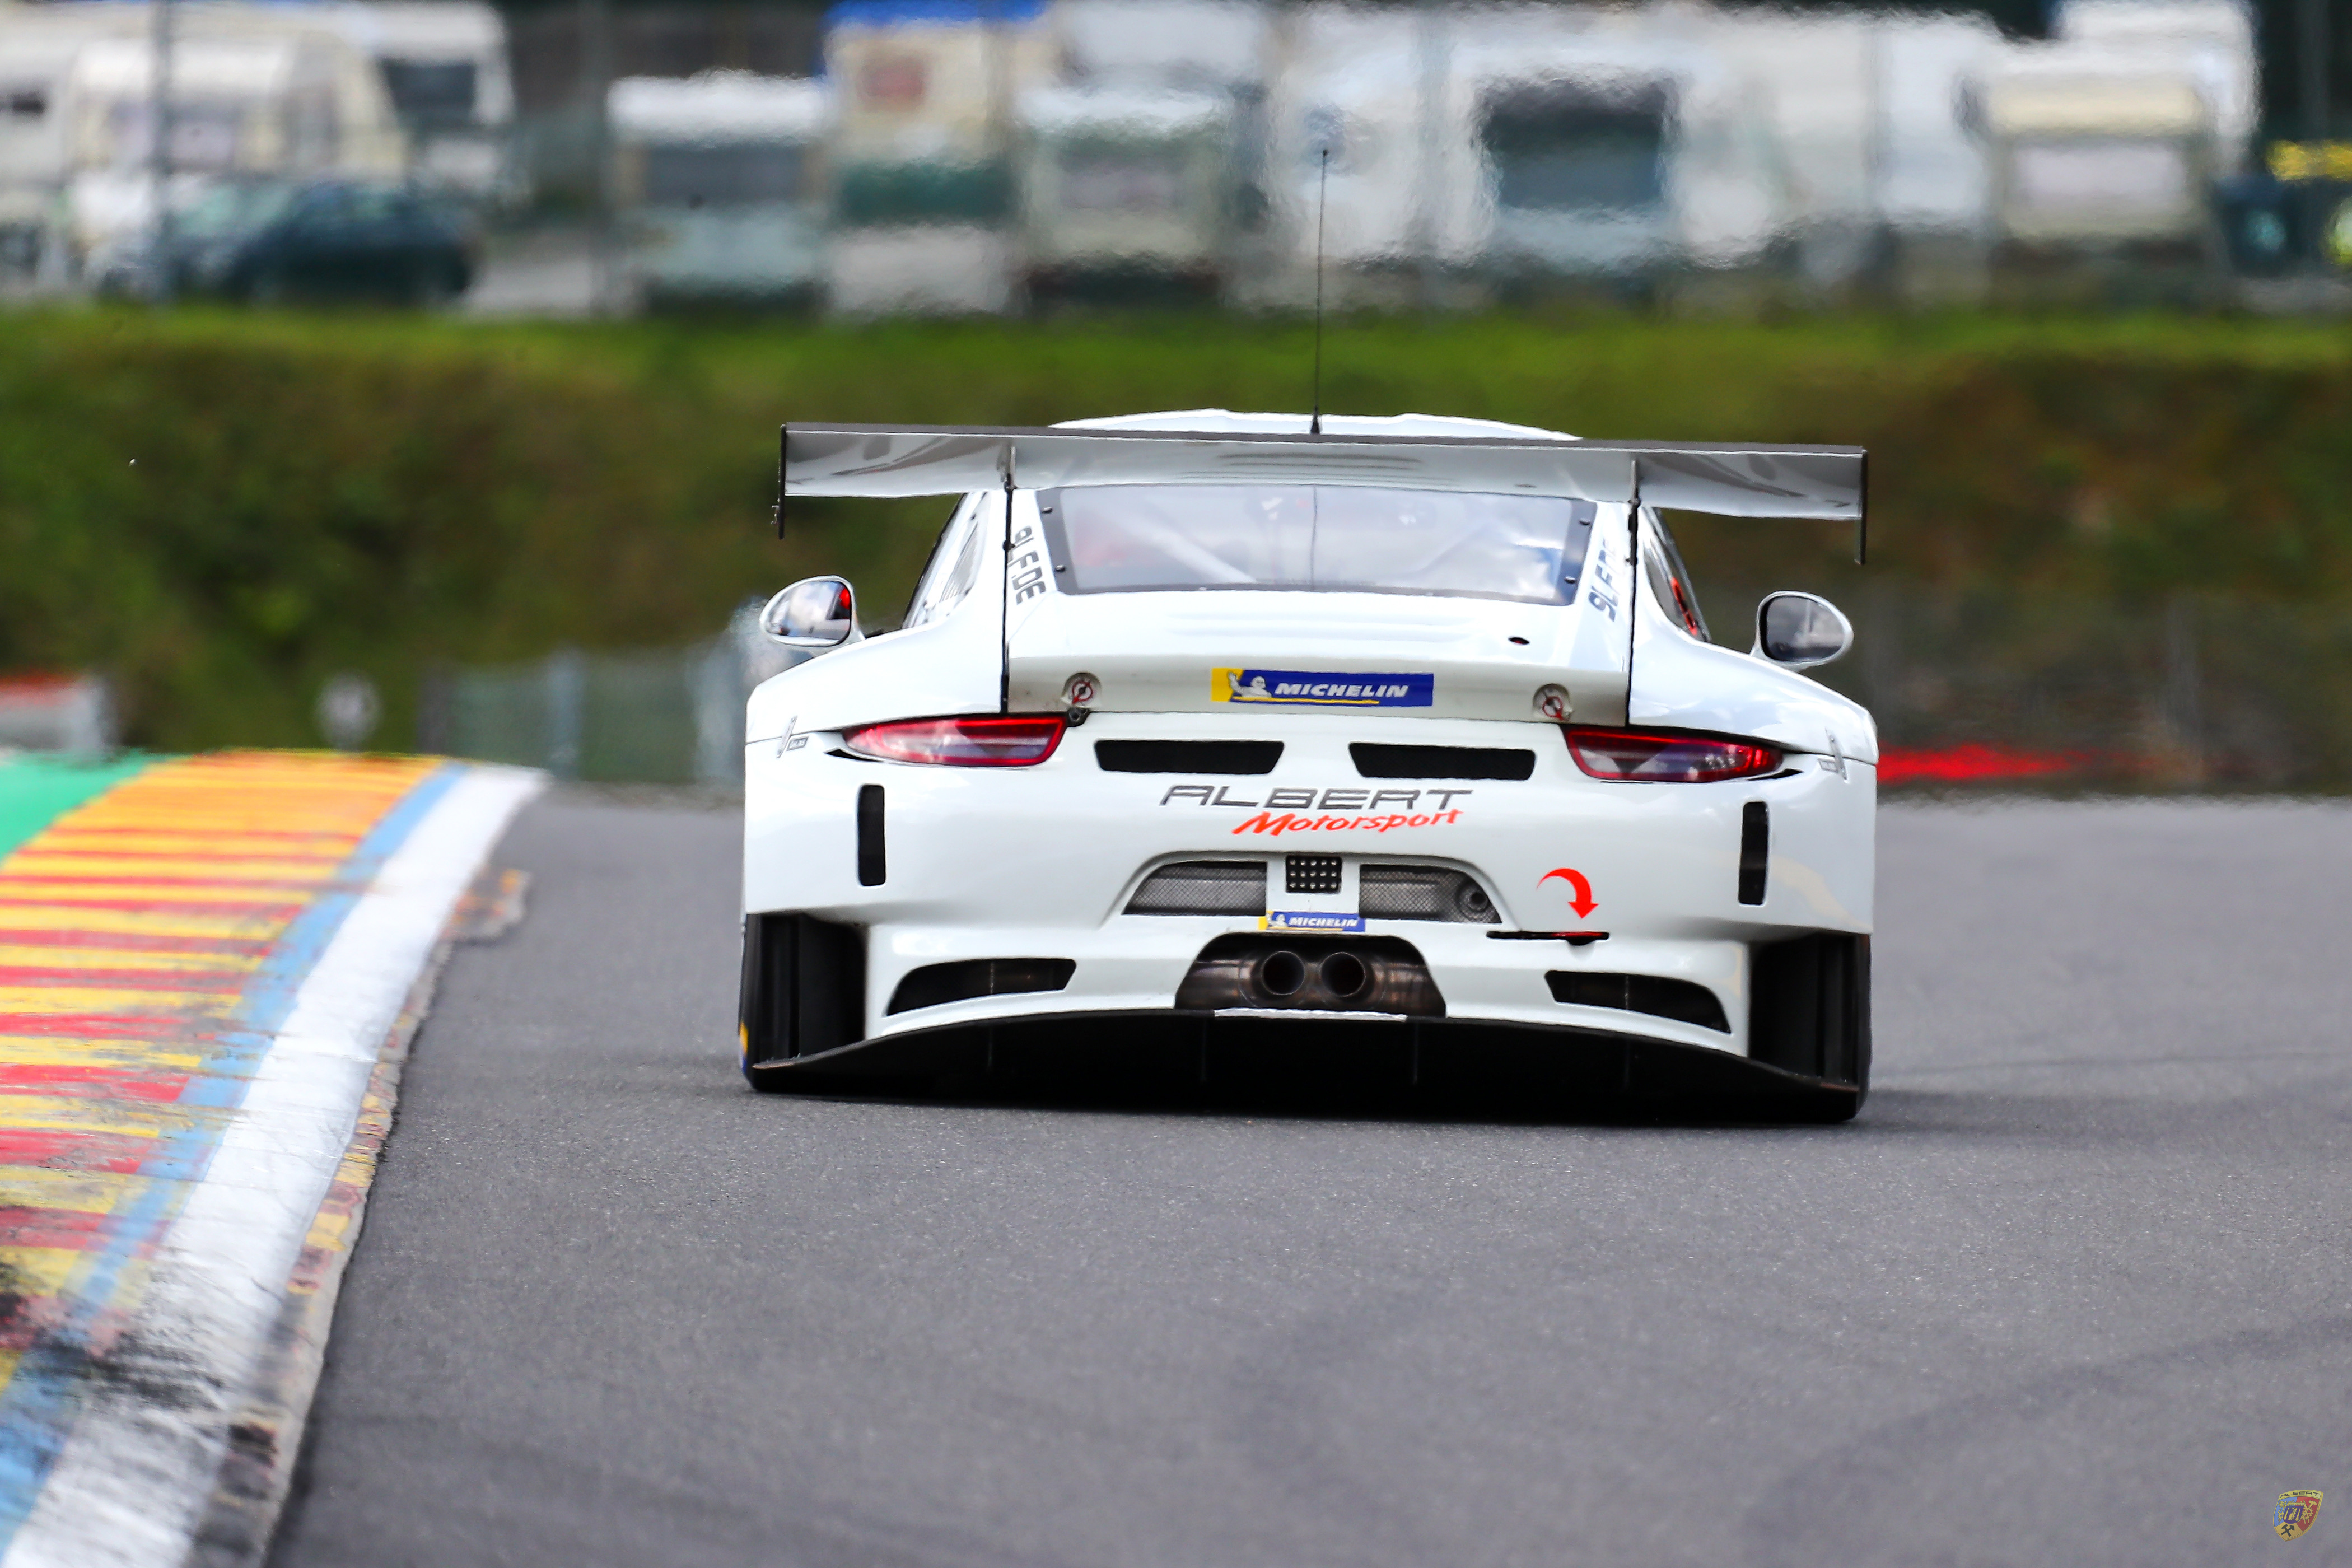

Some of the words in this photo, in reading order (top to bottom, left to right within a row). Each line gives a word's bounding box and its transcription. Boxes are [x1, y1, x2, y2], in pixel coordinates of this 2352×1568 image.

[1274, 682, 1409, 698] MICHELIN
[1160, 785, 1473, 810] ALBERT
[1232, 808, 1463, 836] Motorsport
[1289, 916, 1358, 927] MICHELIN
